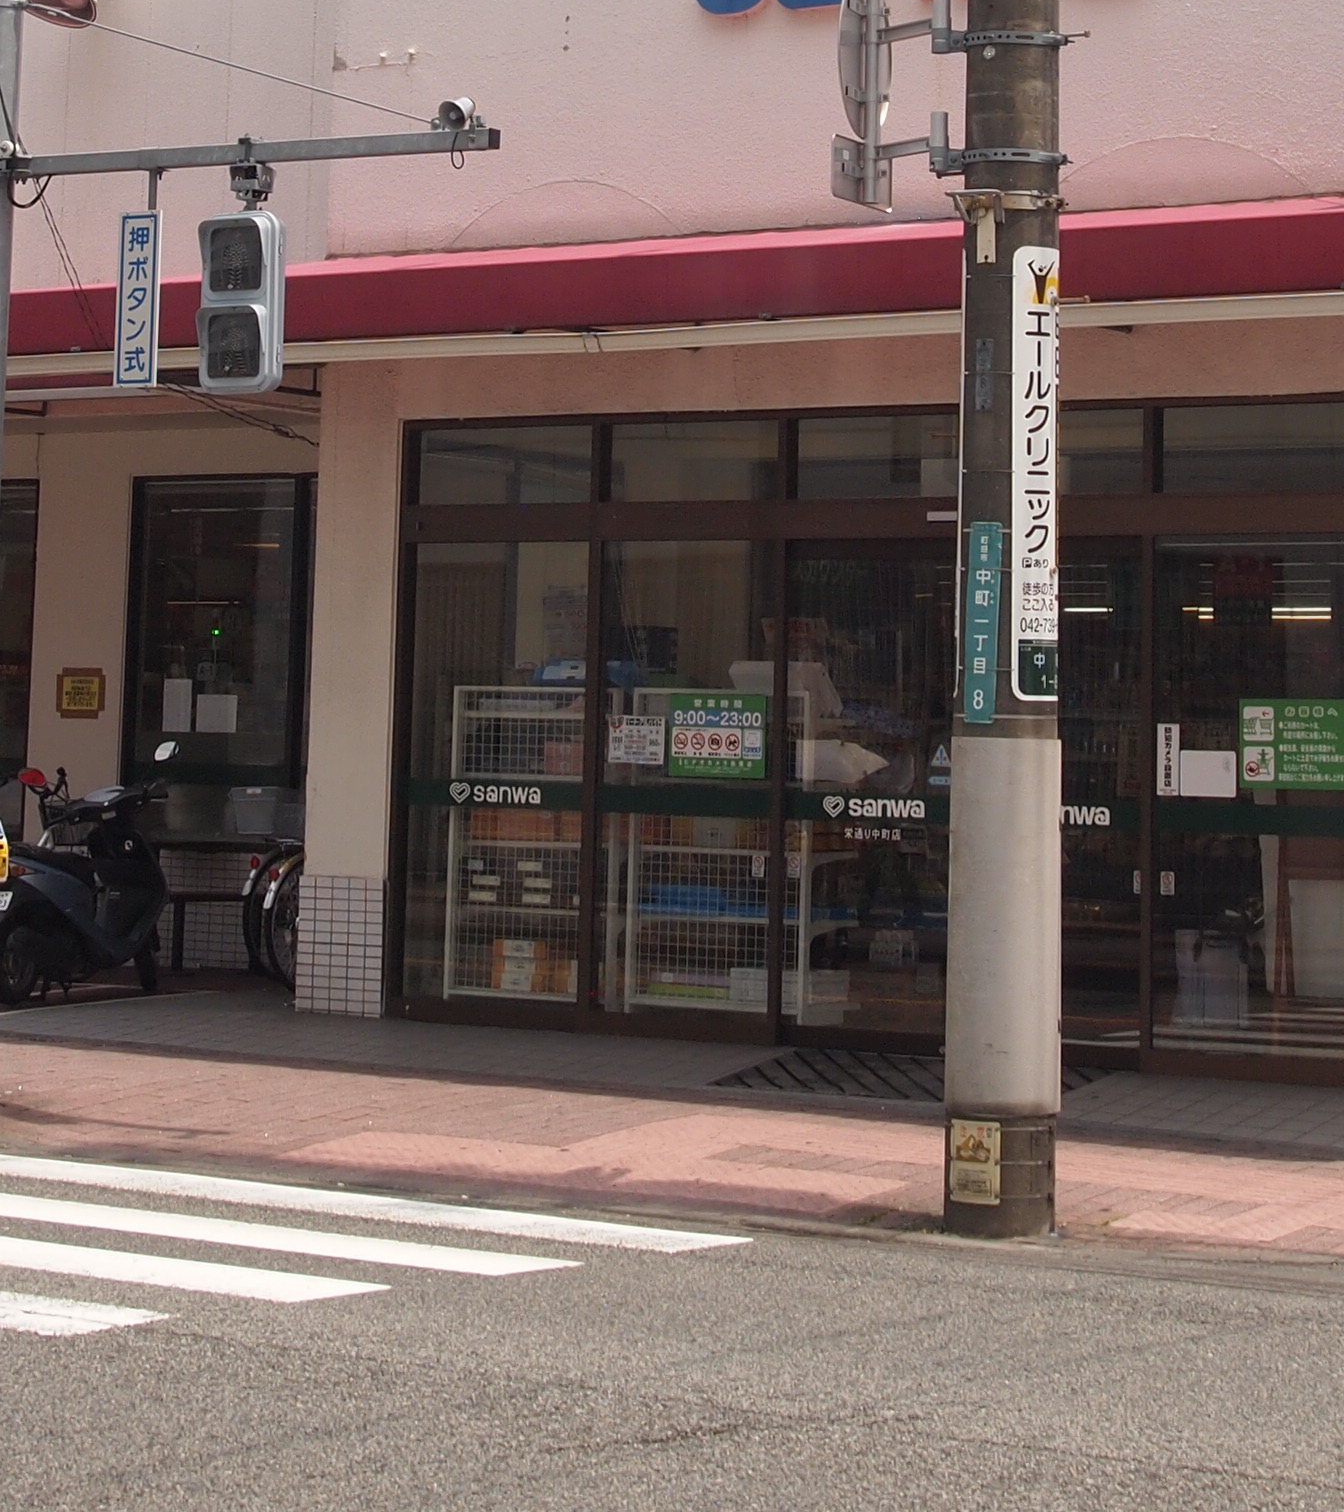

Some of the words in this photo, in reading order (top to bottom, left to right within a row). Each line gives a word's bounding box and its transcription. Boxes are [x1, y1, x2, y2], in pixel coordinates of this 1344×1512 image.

[123, 226, 150, 375] 押ボタン式
[1024, 311, 1051, 554] エールクリニック
[973, 689, 984, 710] 8
[473, 785, 541, 804] sanwa
[848, 798, 925, 819] sanwa
[1061, 805, 1111, 826] nwa
